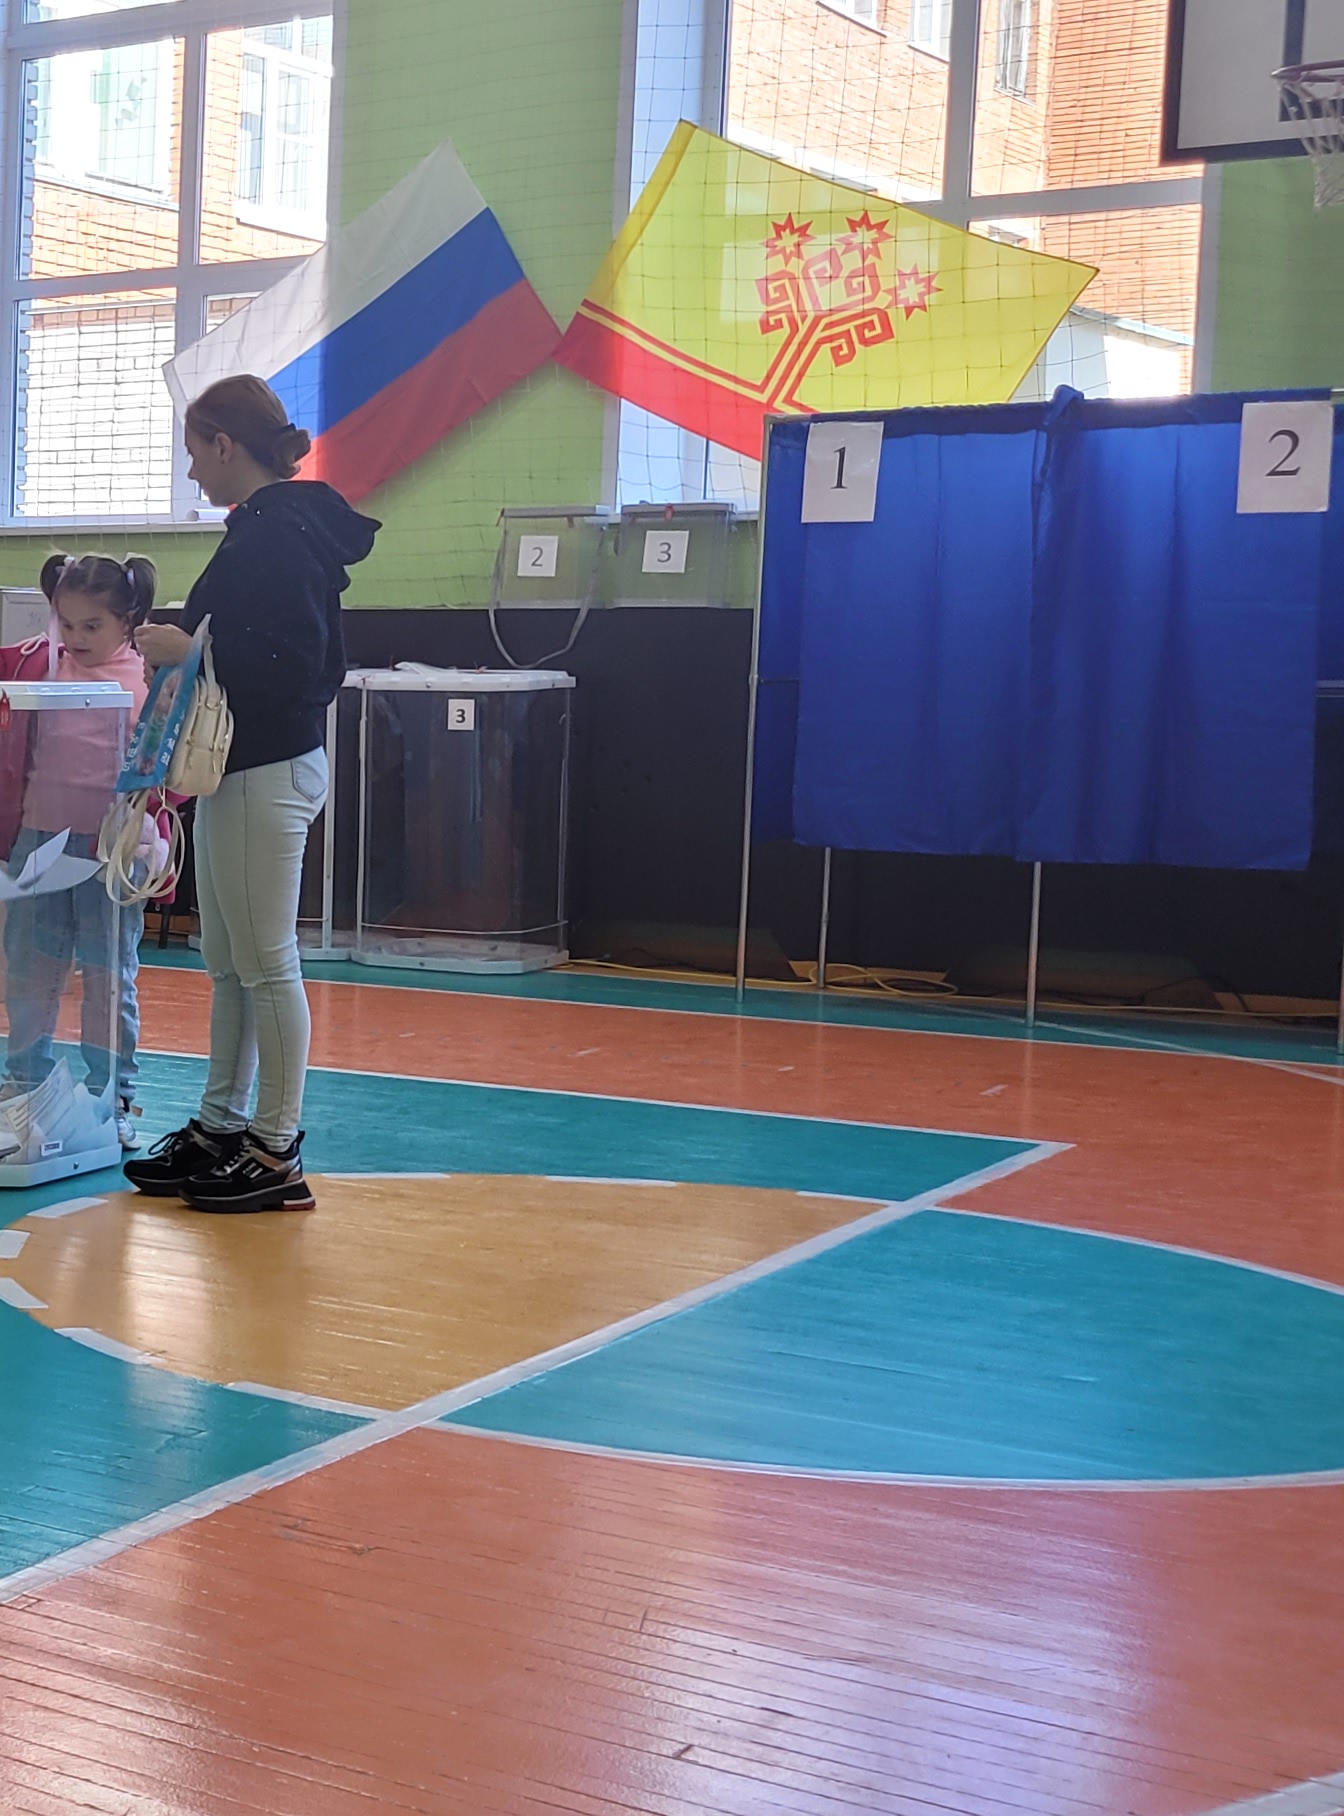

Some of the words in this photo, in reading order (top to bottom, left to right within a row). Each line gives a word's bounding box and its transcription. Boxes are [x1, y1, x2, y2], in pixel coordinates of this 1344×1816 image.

[1265, 429, 1302, 477] 2
[830, 446, 848, 490] 1
[530, 546, 544, 568] 2
[656, 541, 673, 564] 3
[455, 708, 466, 724] 3
